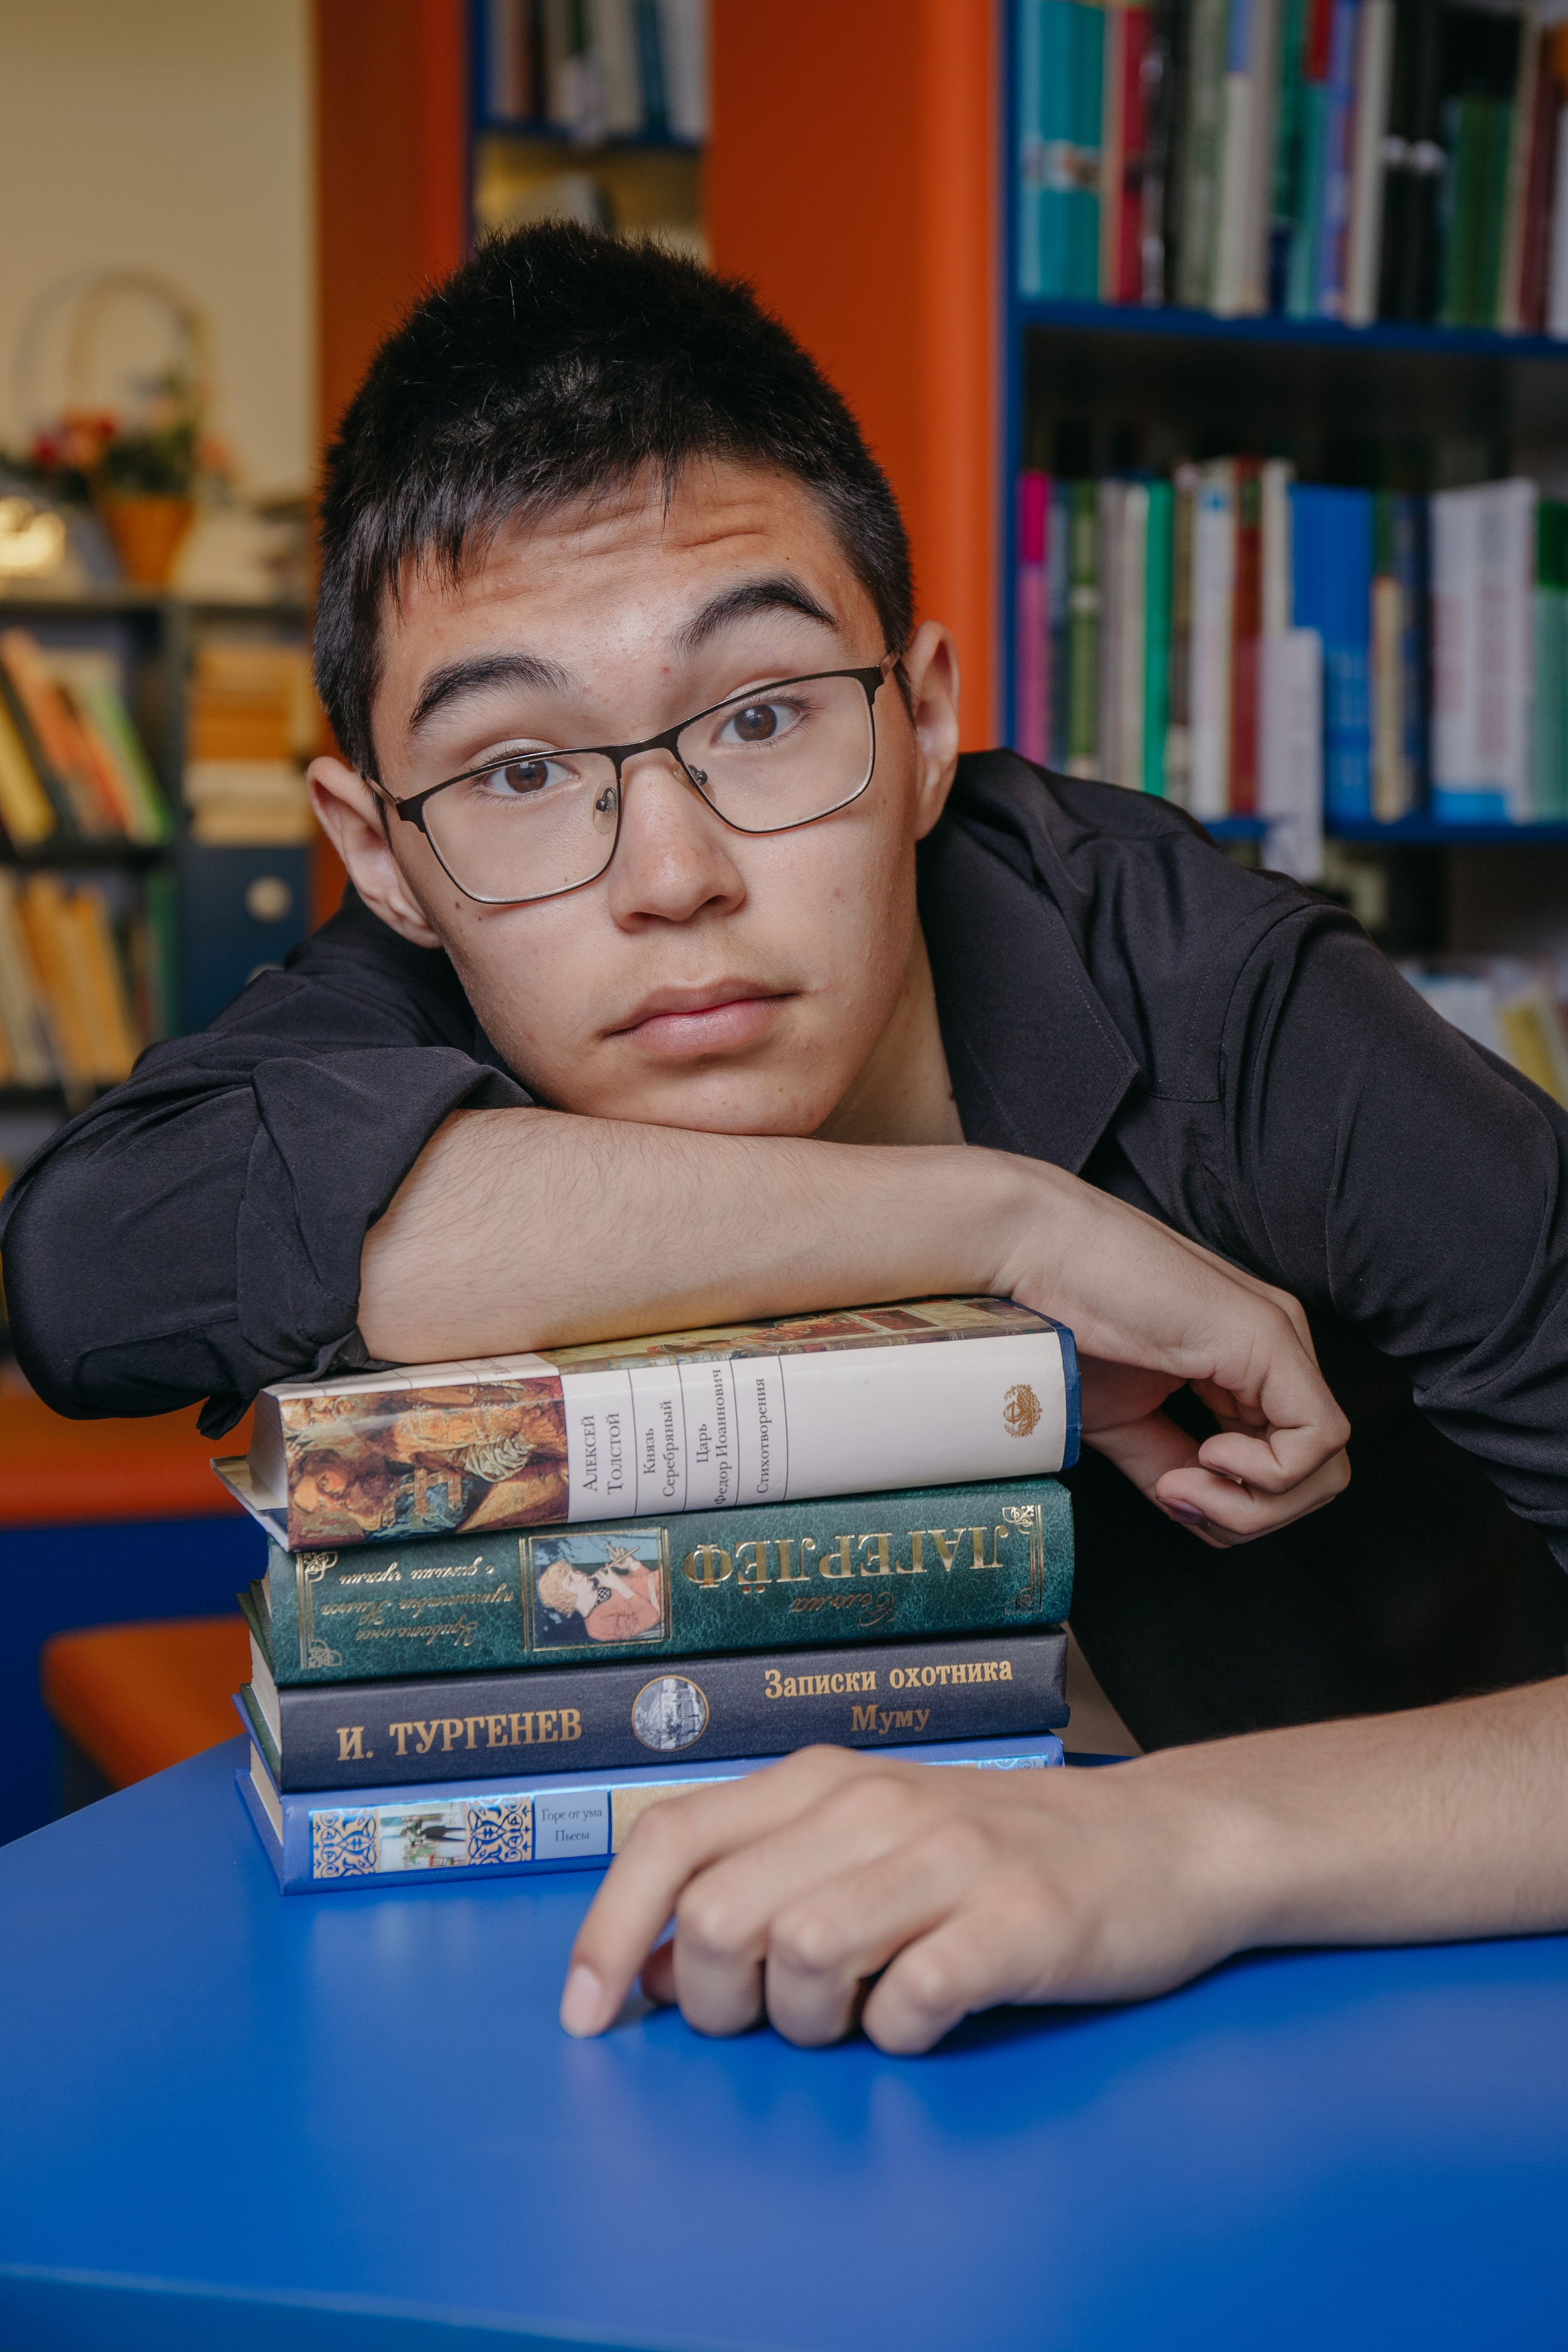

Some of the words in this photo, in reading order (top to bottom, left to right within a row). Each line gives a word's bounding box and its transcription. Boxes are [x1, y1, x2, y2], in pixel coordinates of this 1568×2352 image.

[712, 1369, 728, 1457] Иоаннович
[643, 1428, 656, 1475] Князь
[660, 1400, 679, 1497] Серебряный
[696, 1423, 712, 1464] Царь
[756, 1378, 772, 1494] Стихотворения
[714, 1461, 733, 1505] Федор
[337, 1561, 402, 1585] гусями
[484, 1563, 494, 1575] с
[682, 1524, 1009, 1594] ЛАГЕРЛЁФ
[319, 1598, 391, 1625] Нильса
[789, 1589, 897, 1626] Сельма
[355, 1613, 478, 1647] Удивительное
[764, 1668, 877, 1699] Записки
[889, 1660, 1013, 1689] охотника
[336, 1726, 374, 1761] И.
[389, 1708, 582, 1755] ТУРГЕНЕВ
[850, 1704, 931, 1735] Муму
[542, 1809, 565, 1824] Горе
[568, 1811, 580, 1820] от
[582, 1809, 603, 1822] ума
[555, 1830, 590, 1842] Пьесы
